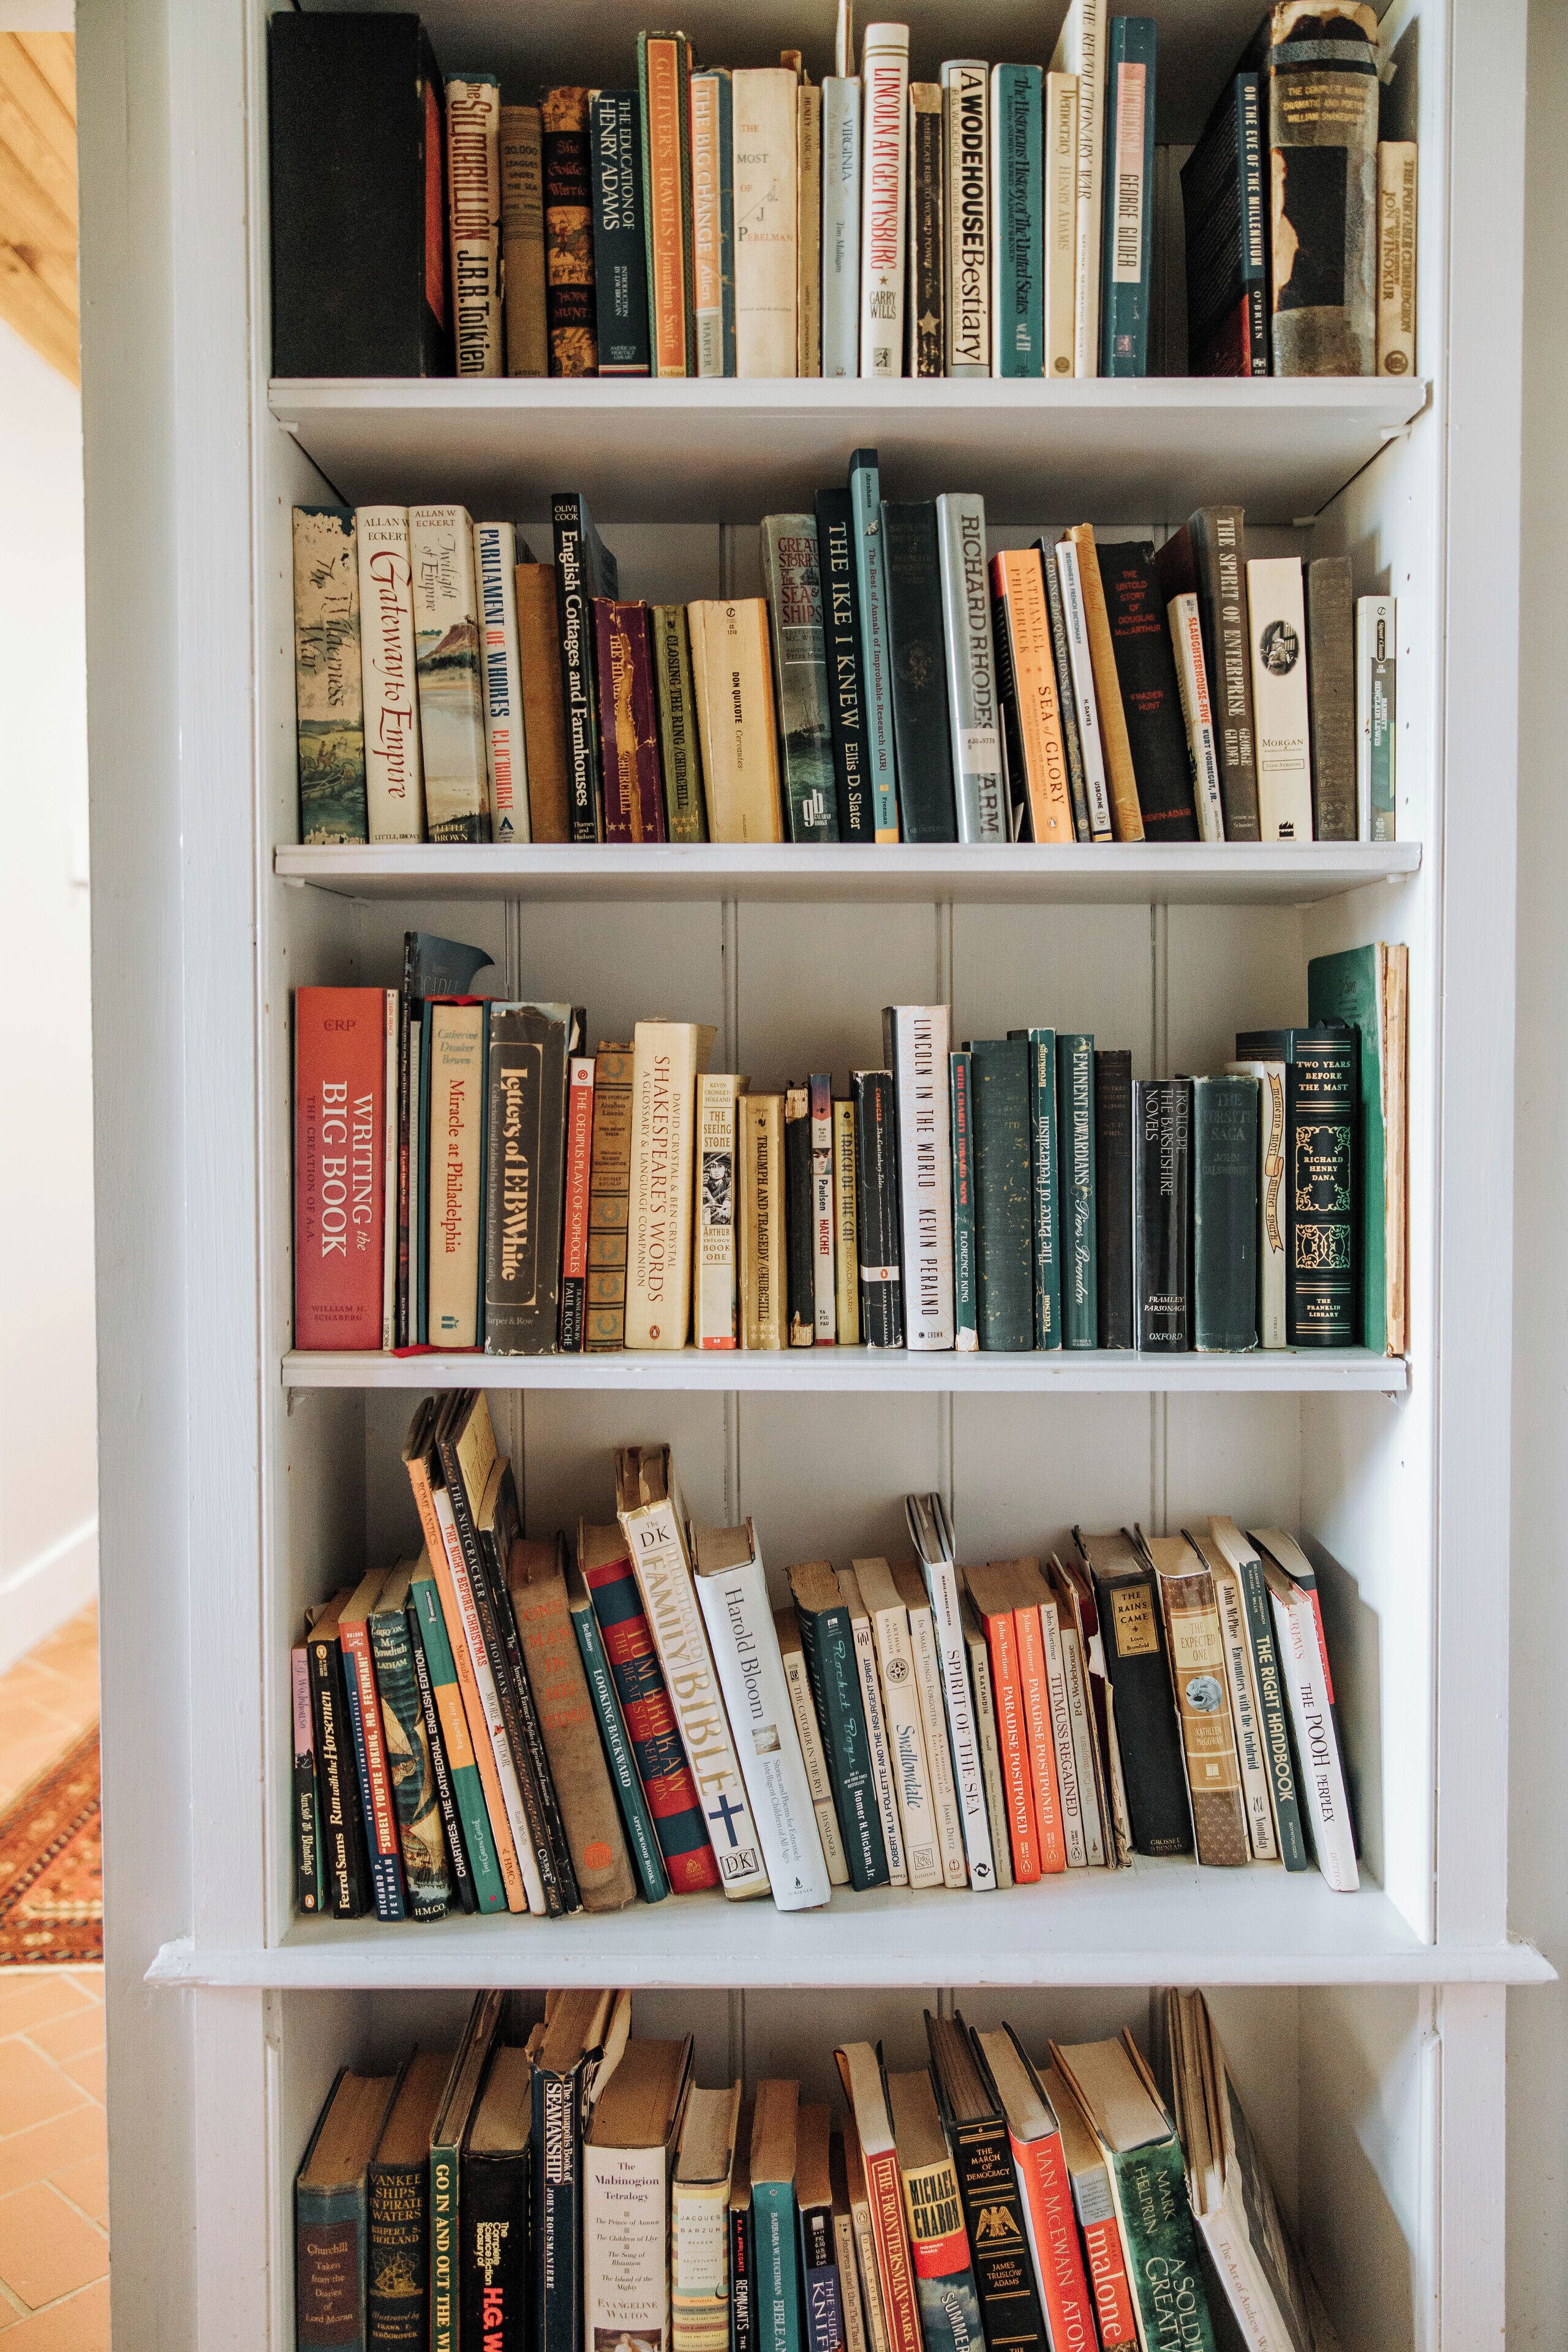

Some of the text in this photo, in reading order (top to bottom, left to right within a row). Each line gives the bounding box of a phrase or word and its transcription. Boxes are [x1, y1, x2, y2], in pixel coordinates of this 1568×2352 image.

[450, 100, 492, 241] SILMARILLION
[599, 99, 619, 230] HENRY ADAMS
[618, 99, 635, 230] THE EDUCATION OF
[695, 88, 712, 252] THE BIG CHANGE
[842, 120, 853, 181] VIRGINIA
[870, 68, 900, 270] LINCOLN AT GETTYSBURG
[1244, 86, 1262, 265] ON THE EVE OF THE MILLENNIUM
[955, 73, 985, 360] A WODEHOUSE Bestiary
[1117, 174, 1139, 267] GEORGE GILDER
[1383, 190, 1396, 300] JON WINOKUR
[703, 322, 712, 367] HARPER
[870, 291, 896, 305] GARRY
[870, 306, 896, 319] WILLS
[1253, 291, 1263, 339] O'BRIEN
[480, 529, 510, 717] PARLIAMENT OF WHORES
[829, 522, 859, 729] THE IKE I KNEW
[871, 592, 877, 601] of
[961, 514, 987, 630] RICHARD
[370, 551, 413, 799] Gateway to Empire
[560, 531, 589, 805] English Cottages and Farmhouses
[873, 650, 884, 701] Improbable
[874, 638, 881, 648] of
[1189, 617, 1210, 724] SLAUGHTERHOUSE-FIVE
[733, 690, 742, 723] QUIXOTE
[876, 704, 886, 745] Research
[878, 749, 888, 771] (AIR)
[1202, 729, 1212, 748] KURT
[492, 729, 514, 812] P.J. O'ROURKE
[844, 743, 862, 829] Ellis D. Slater
[977, 773, 999, 834] ARM
[914, 1020, 936, 1188] LINCOLN IN THE WORLD
[1073, 1053, 1089, 1185] EMINENT EDWARDIANS
[1146, 1090, 1158, 1140] NOVELS
[1160, 1089, 1174, 1195] THE BARSETSHIRE
[1176, 1090, 1188, 1153] TROLLOPE
[322, 1080, 347, 1256] BIG BOOK
[353, 1093, 372, 1251] WRITING the
[441, 1080, 464, 1253] Miracle at Philadelphia
[570, 1090, 588, 1272] THE OEDIPUS PLAYS OF SOPHOCLES
[648, 1056, 669, 1302] SHAKESPEARE'S WORDS
[818, 1180, 827, 1211] Paulsen
[820, 1219, 829, 1256] HATCHET
[920, 1209, 939, 1316] KEVIN PERAINO
[960, 1231, 970, 1302] FLORENCE KING
[725, 1588, 768, 1720] Harold Bloom
[592, 1668, 633, 1787] LOOKING BACKWARD
[794, 1685, 824, 1796] THE CATCHER IN THE RYE
[946, 1650, 980, 1816] SPIRIT OF THE SEA
[1003, 1686, 1028, 1834] PARADISE POSTPONED
[1050, 1673, 1079, 1817] TITMUSS REGAINED
[1255, 1635, 1295, 1801] THE RIGHT HANDBOOK
[1300, 1684, 1335, 1823] THE POOH PERPLEX
[301, 1793, 314, 1875] Sunset at Blandings
[546, 2083, 562, 2183] SEAMANSHIP
[562, 2082, 573, 2181] The Annapolis Book of
[1036, 2149, 1056, 2189] IAN
[1134, 2168, 1159, 2235] HELPRIN
[1155, 2170, 1176, 2222] MARK
[734, 2280, 748, 2330] REMNANTS
[877, 2161, 914, 2343] THE FRONTIERSMAN MARK
[987, 2269, 1023, 2280] TRUSLOW
[993, 2277, 1020, 2287] ADAMS
[1086, 2228, 1124, 2339] malone
